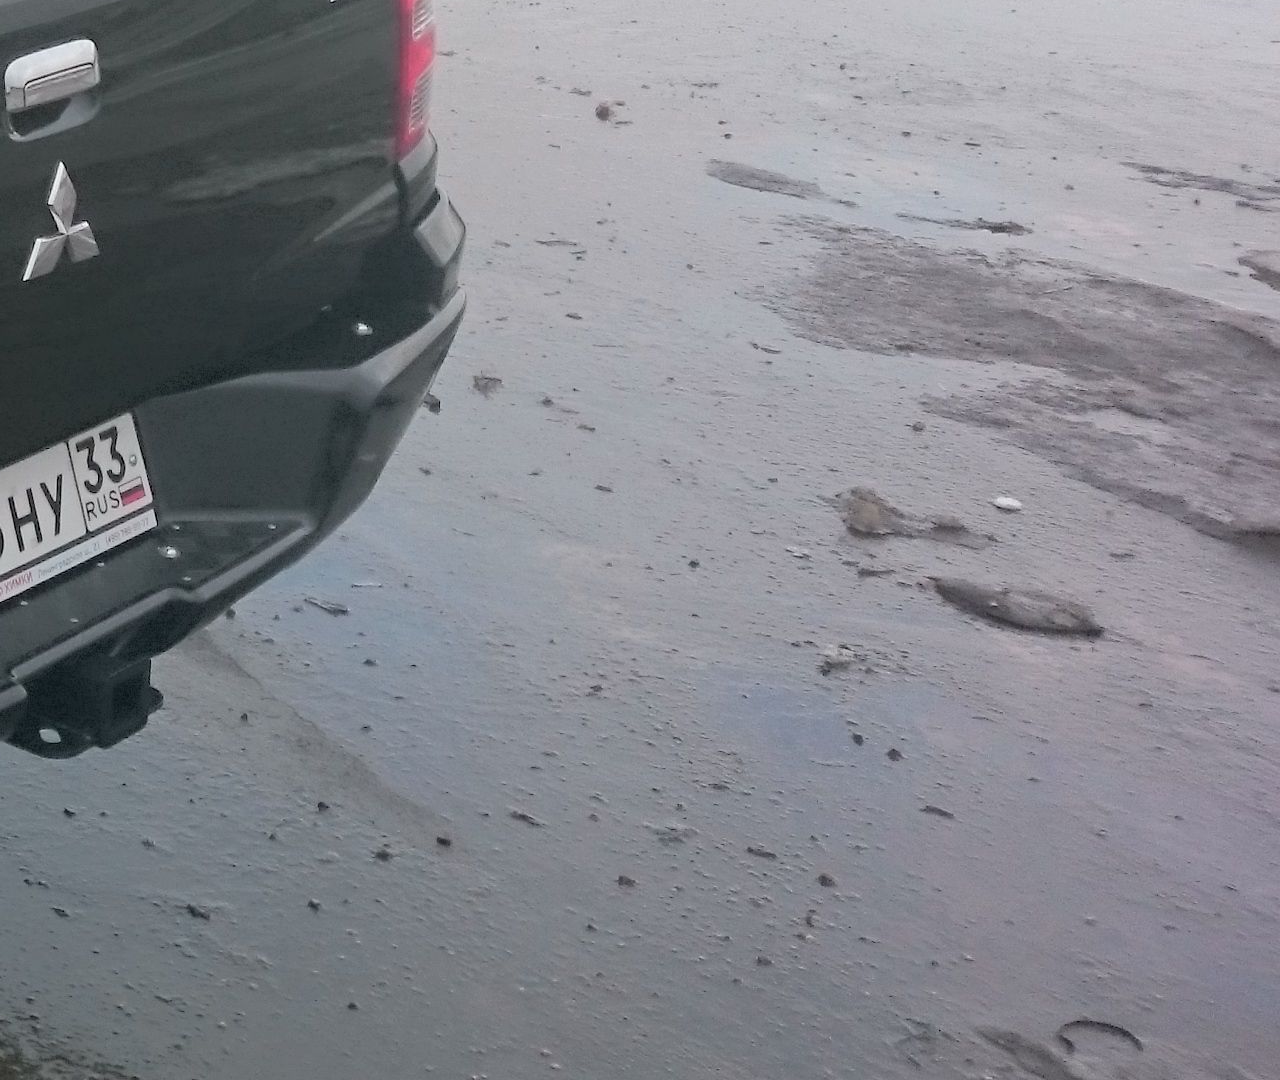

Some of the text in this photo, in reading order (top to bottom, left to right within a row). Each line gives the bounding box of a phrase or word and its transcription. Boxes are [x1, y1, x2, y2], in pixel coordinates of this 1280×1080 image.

[75, 426, 127, 494] 33
[86, 491, 121, 520] RUS
[4, 572, 34, 594] ХИМКИ
